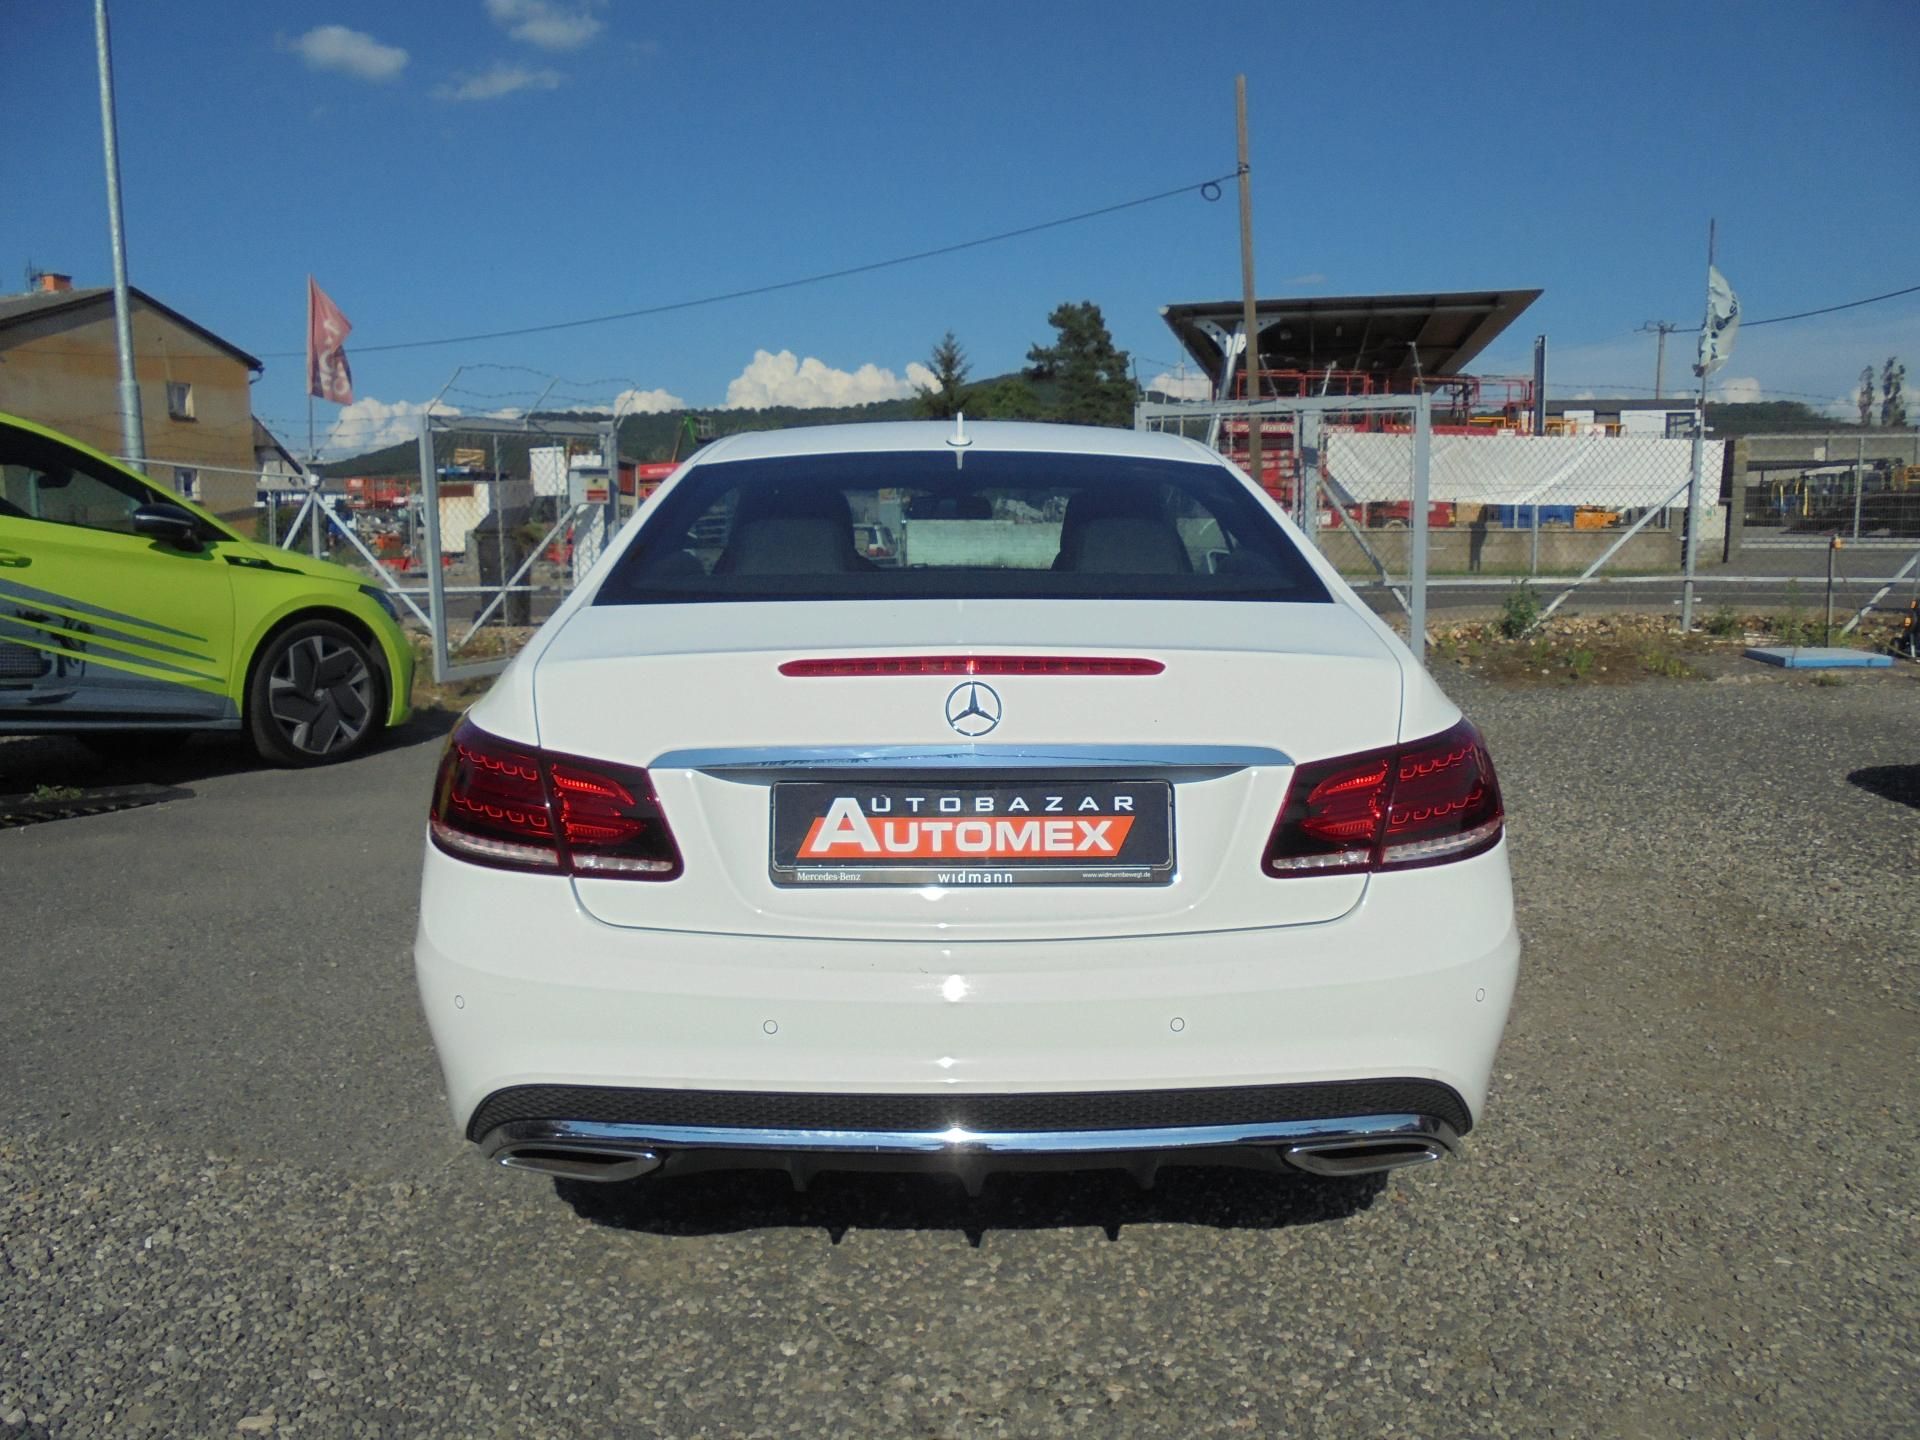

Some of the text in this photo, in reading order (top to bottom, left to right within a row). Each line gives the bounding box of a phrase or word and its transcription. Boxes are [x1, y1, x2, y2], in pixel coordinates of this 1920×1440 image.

[810, 797, 1114, 852] AUTOMEX
[796, 872, 861, 882] Mercedes-Benz
[937, 871, 1014, 883] widmann
